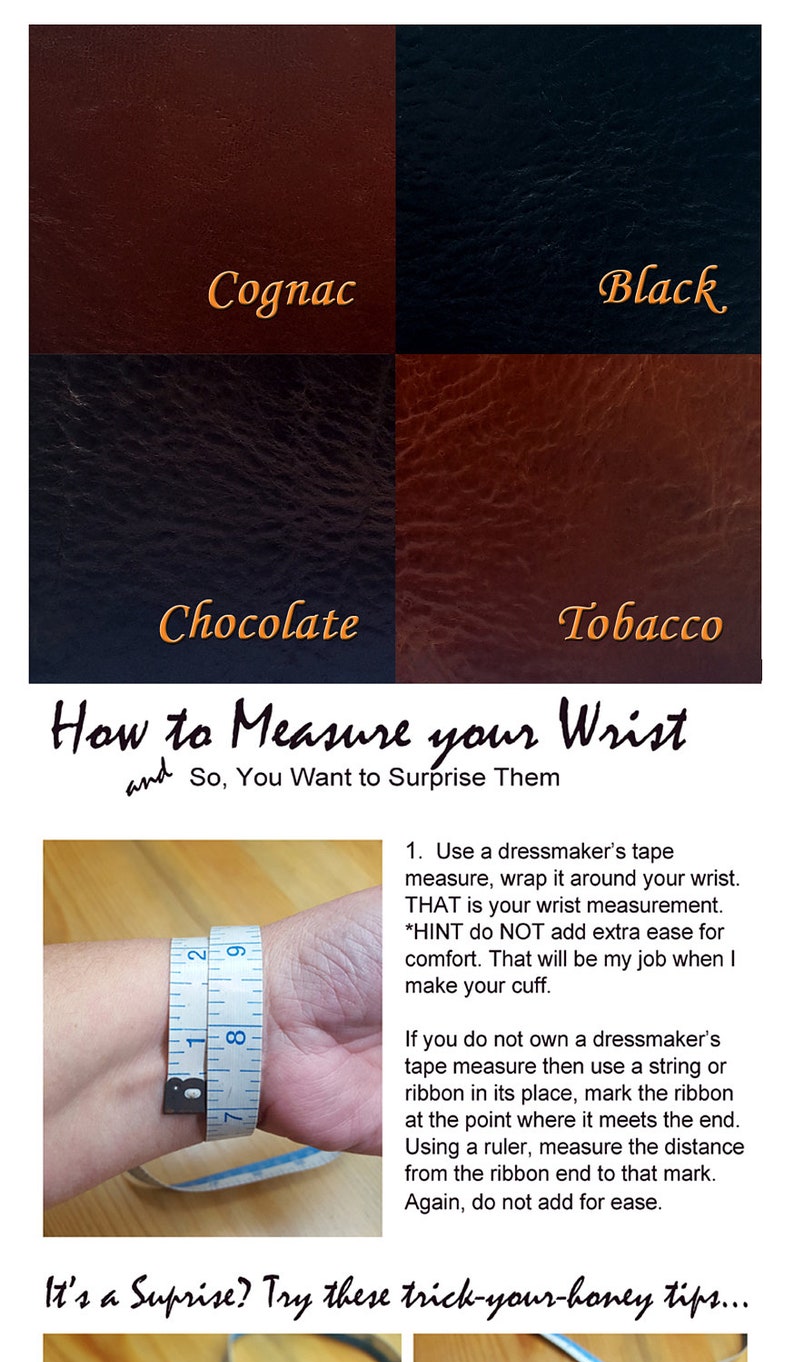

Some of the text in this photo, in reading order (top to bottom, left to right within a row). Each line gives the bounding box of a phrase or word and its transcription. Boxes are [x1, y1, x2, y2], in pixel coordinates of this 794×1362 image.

[187, 950, 206, 961] 2
[226, 945, 246, 957] 9
[186, 1038, 206, 1048] 1
[225, 1030, 246, 1045] 8
[224, 1112, 243, 1123] 7
